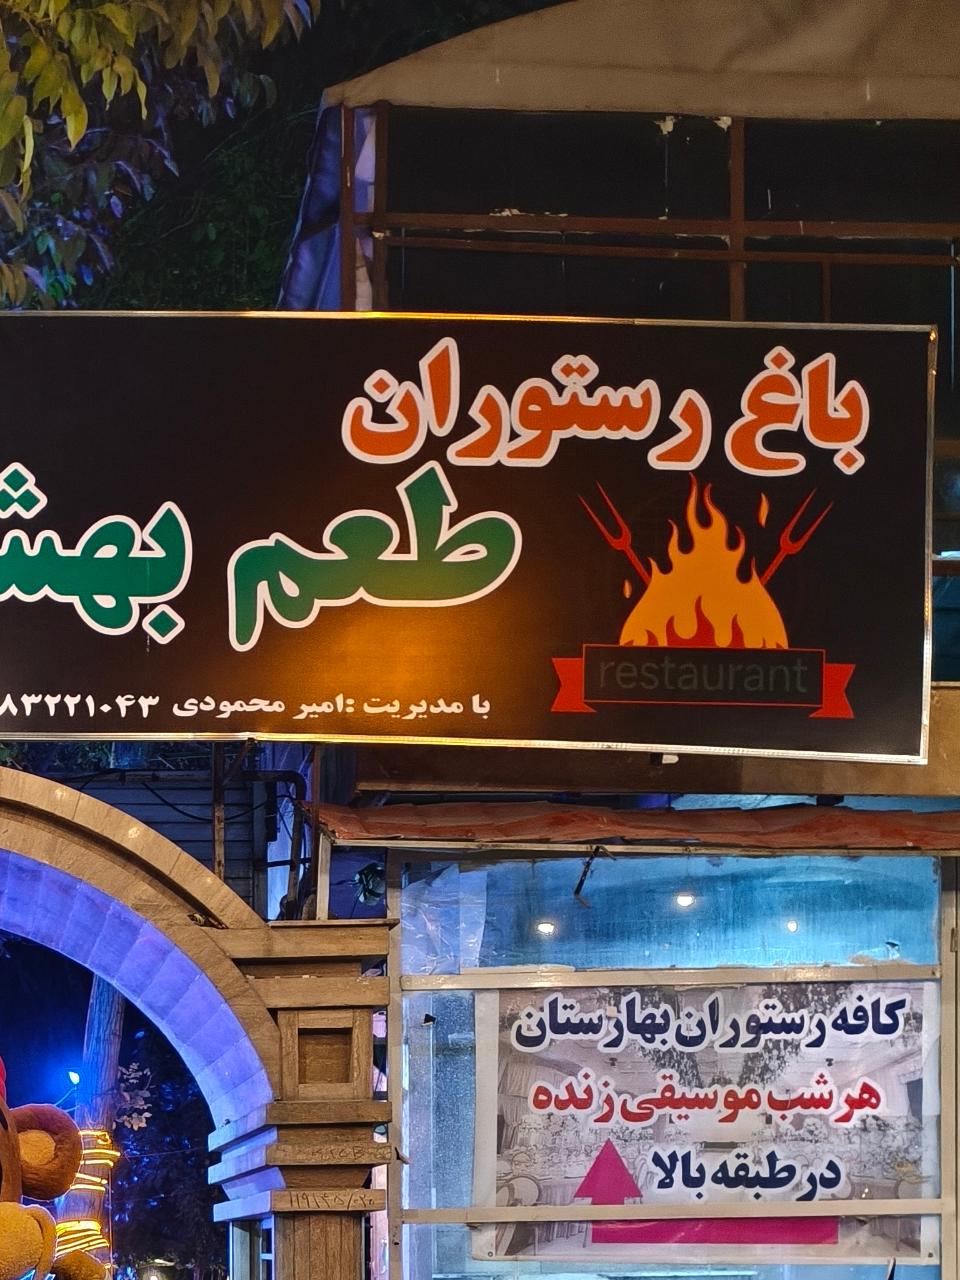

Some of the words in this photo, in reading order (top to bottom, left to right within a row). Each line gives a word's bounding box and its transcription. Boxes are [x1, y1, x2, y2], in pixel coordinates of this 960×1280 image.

[341, 337, 711, 470] رستوران
[725, 346, 869, 476] باغ
[228, 460, 522, 651] طعم
[599, 655, 809, 694] restaurant
[172, 694, 286, 719] محمودی
[362, 694, 464, 720] مدیریت
[471, 693, 491, 719] با
[514, 995, 671, 1049] بهارستان
[675, 995, 827, 1048] رستوران
[831, 994, 907, 1036] کافه
[532, 1071, 616, 1123] زنده
[620, 1073, 762, 1123] موسیقی
[651, 1150, 706, 1200] بالا
[710, 1150, 797, 1200] طبقه
[795, 1159, 842, 1201] در
